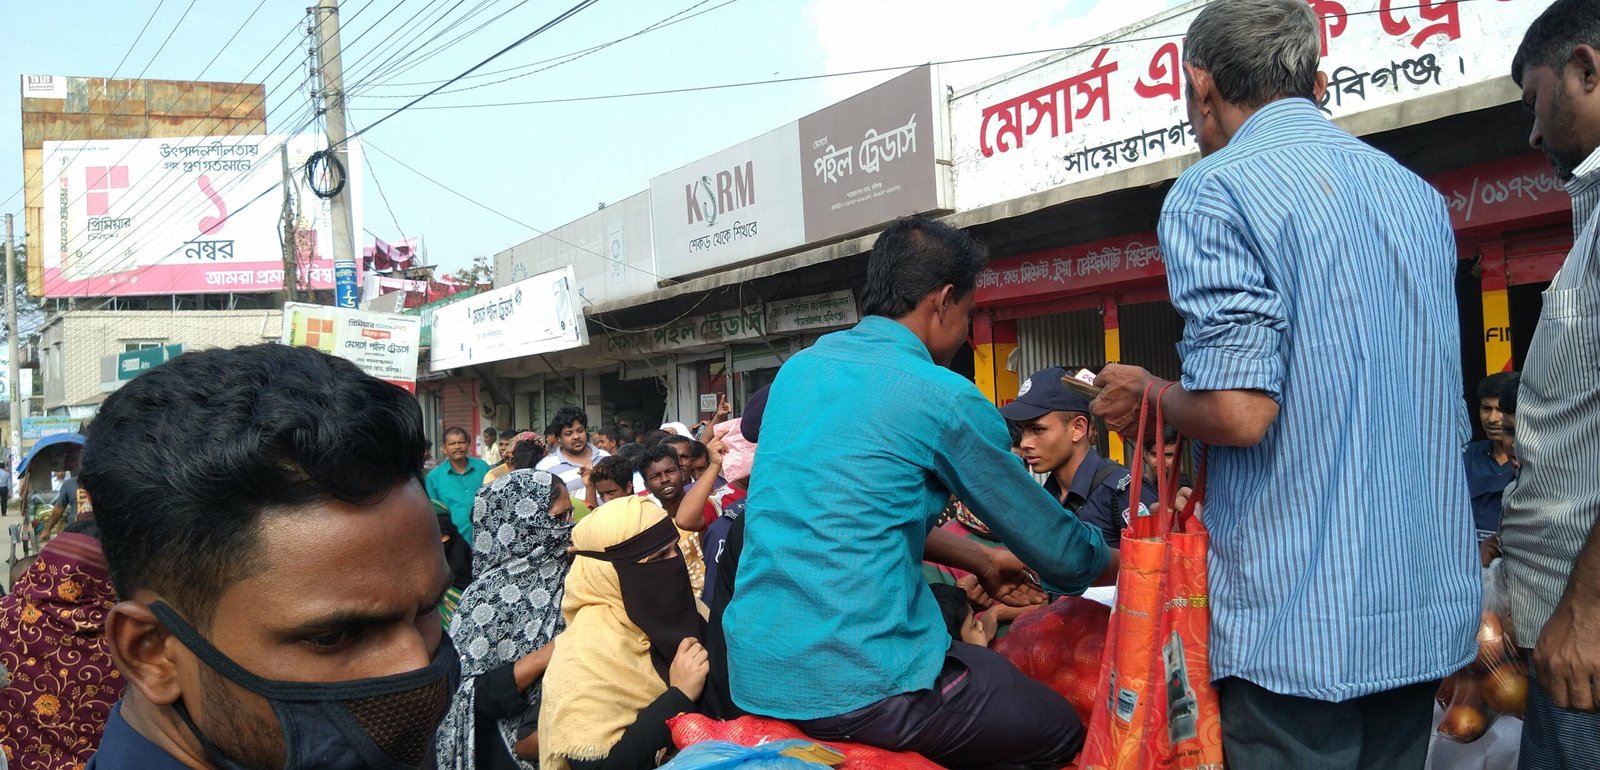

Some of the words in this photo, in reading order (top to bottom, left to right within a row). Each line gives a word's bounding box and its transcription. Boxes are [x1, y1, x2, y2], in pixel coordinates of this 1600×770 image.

[980, 48, 1118, 158] মেসার্স
[160, 141, 259, 158] উৎপাদনশীলতায়
[814, 144, 853, 183] পইল
[859, 113, 917, 173] ট্রেডার্স
[198, 175, 227, 235] ১
[685, 161, 755, 226] KSRM
[88, 217, 131, 231] প্রিমিয়ার
[689, 235, 710, 253] শেকড়
[713, 229, 731, 246] থেকে
[733, 221, 757, 240] শিখরে
[183, 240, 235, 260] নম্বর
[205, 270, 254, 286] আমরা
[257, 270, 300, 284] প্রমা
